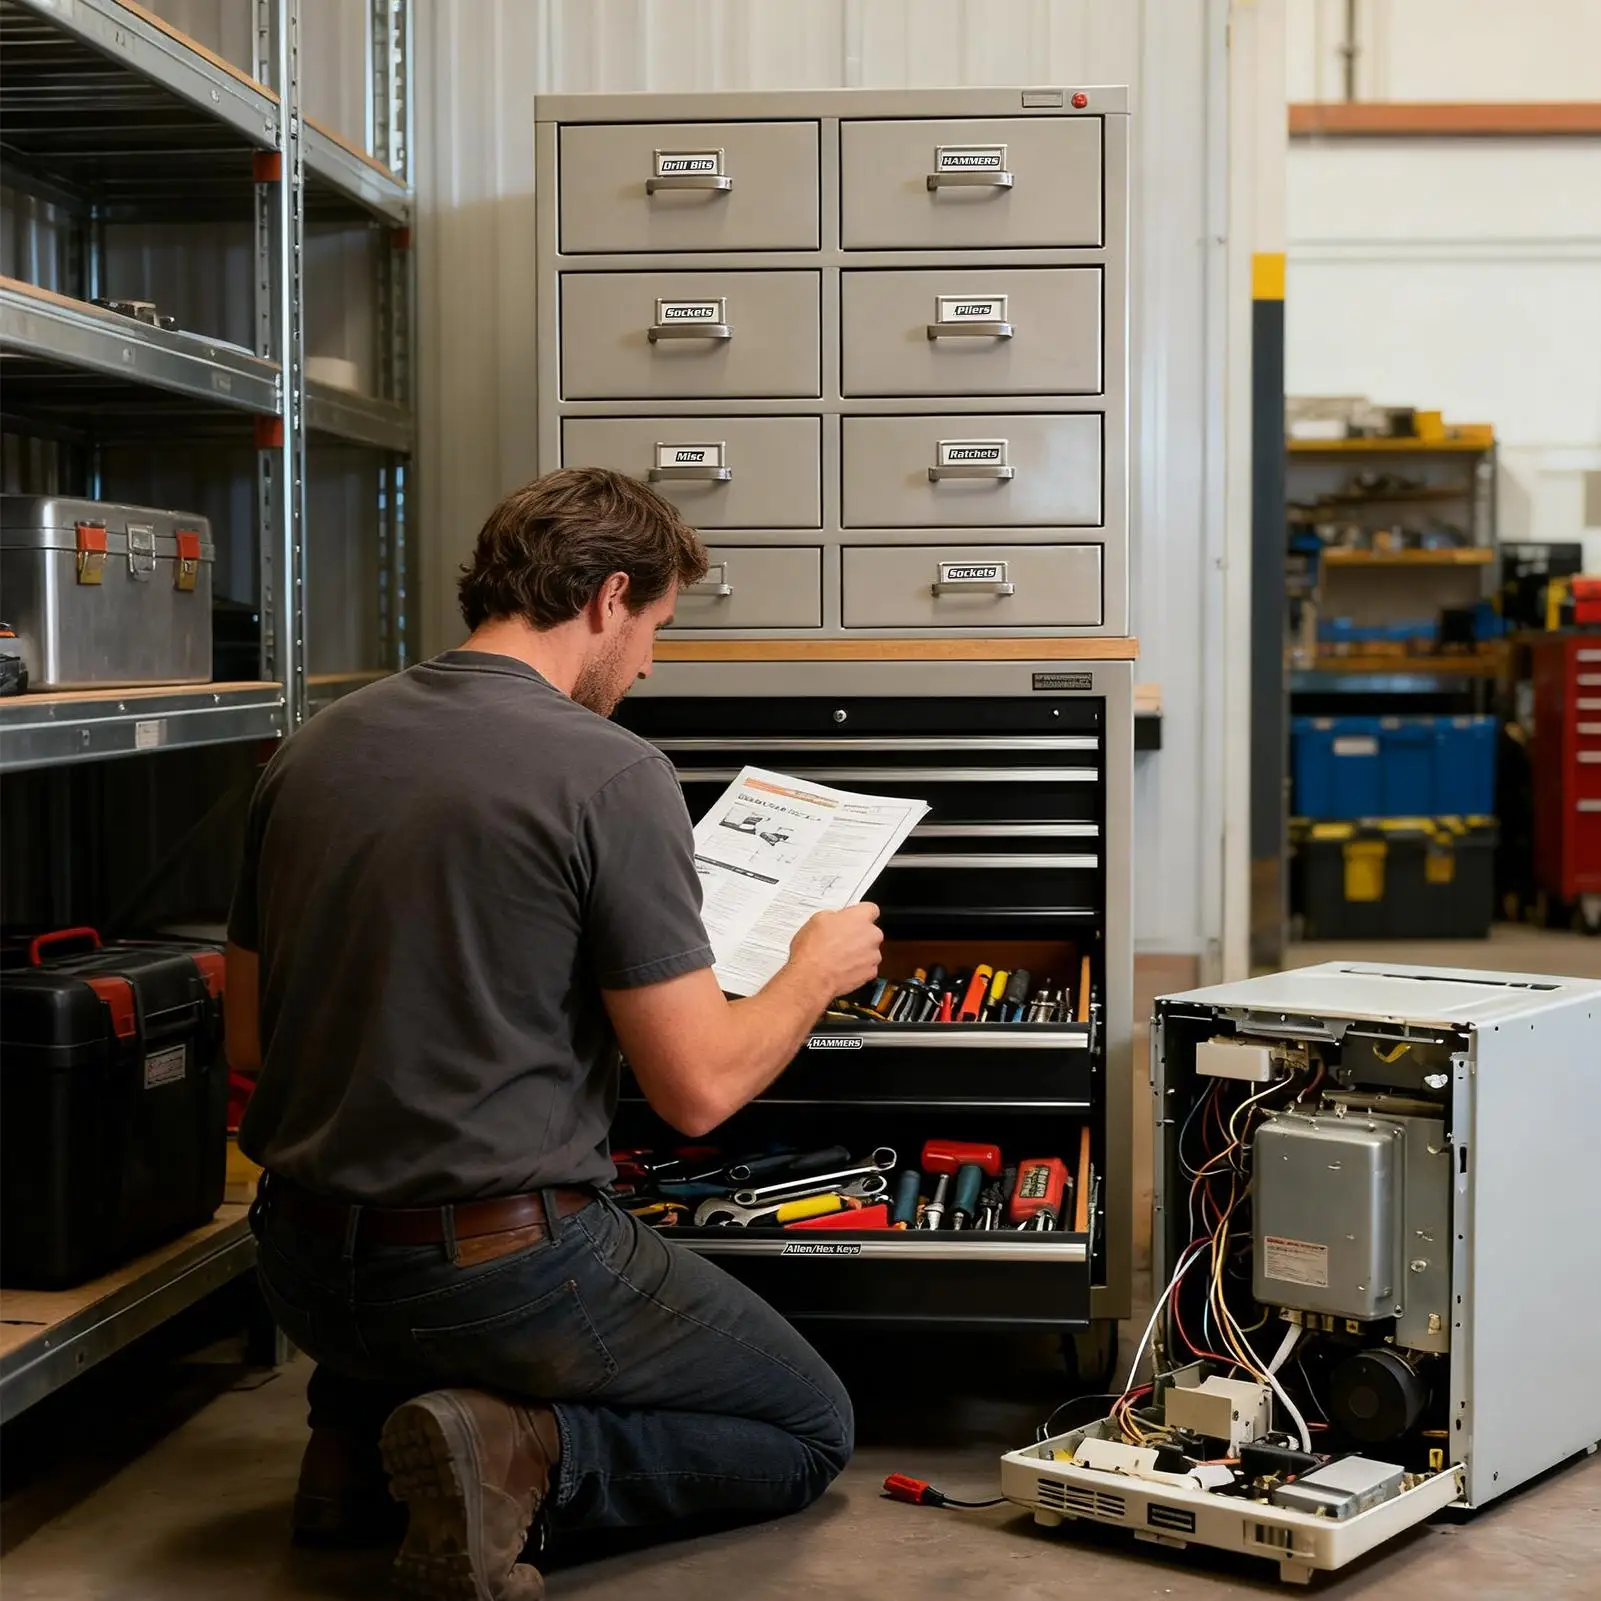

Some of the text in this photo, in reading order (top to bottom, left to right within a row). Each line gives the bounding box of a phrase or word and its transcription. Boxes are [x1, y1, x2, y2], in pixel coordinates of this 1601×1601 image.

[663, 160, 712, 170] Drill Bits
[943, 156, 999, 165] HAMMERS
[666, 308, 713, 317] Sockets
[957, 305, 990, 314] Pliers
[677, 452, 703, 461] Misc
[950, 449, 998, 459] Ratchets
[948, 568, 994, 578] Sockets
[812, 1039, 861, 1048] HAMMERS
[786, 1245, 860, 1255] Allen/Hex Keys
